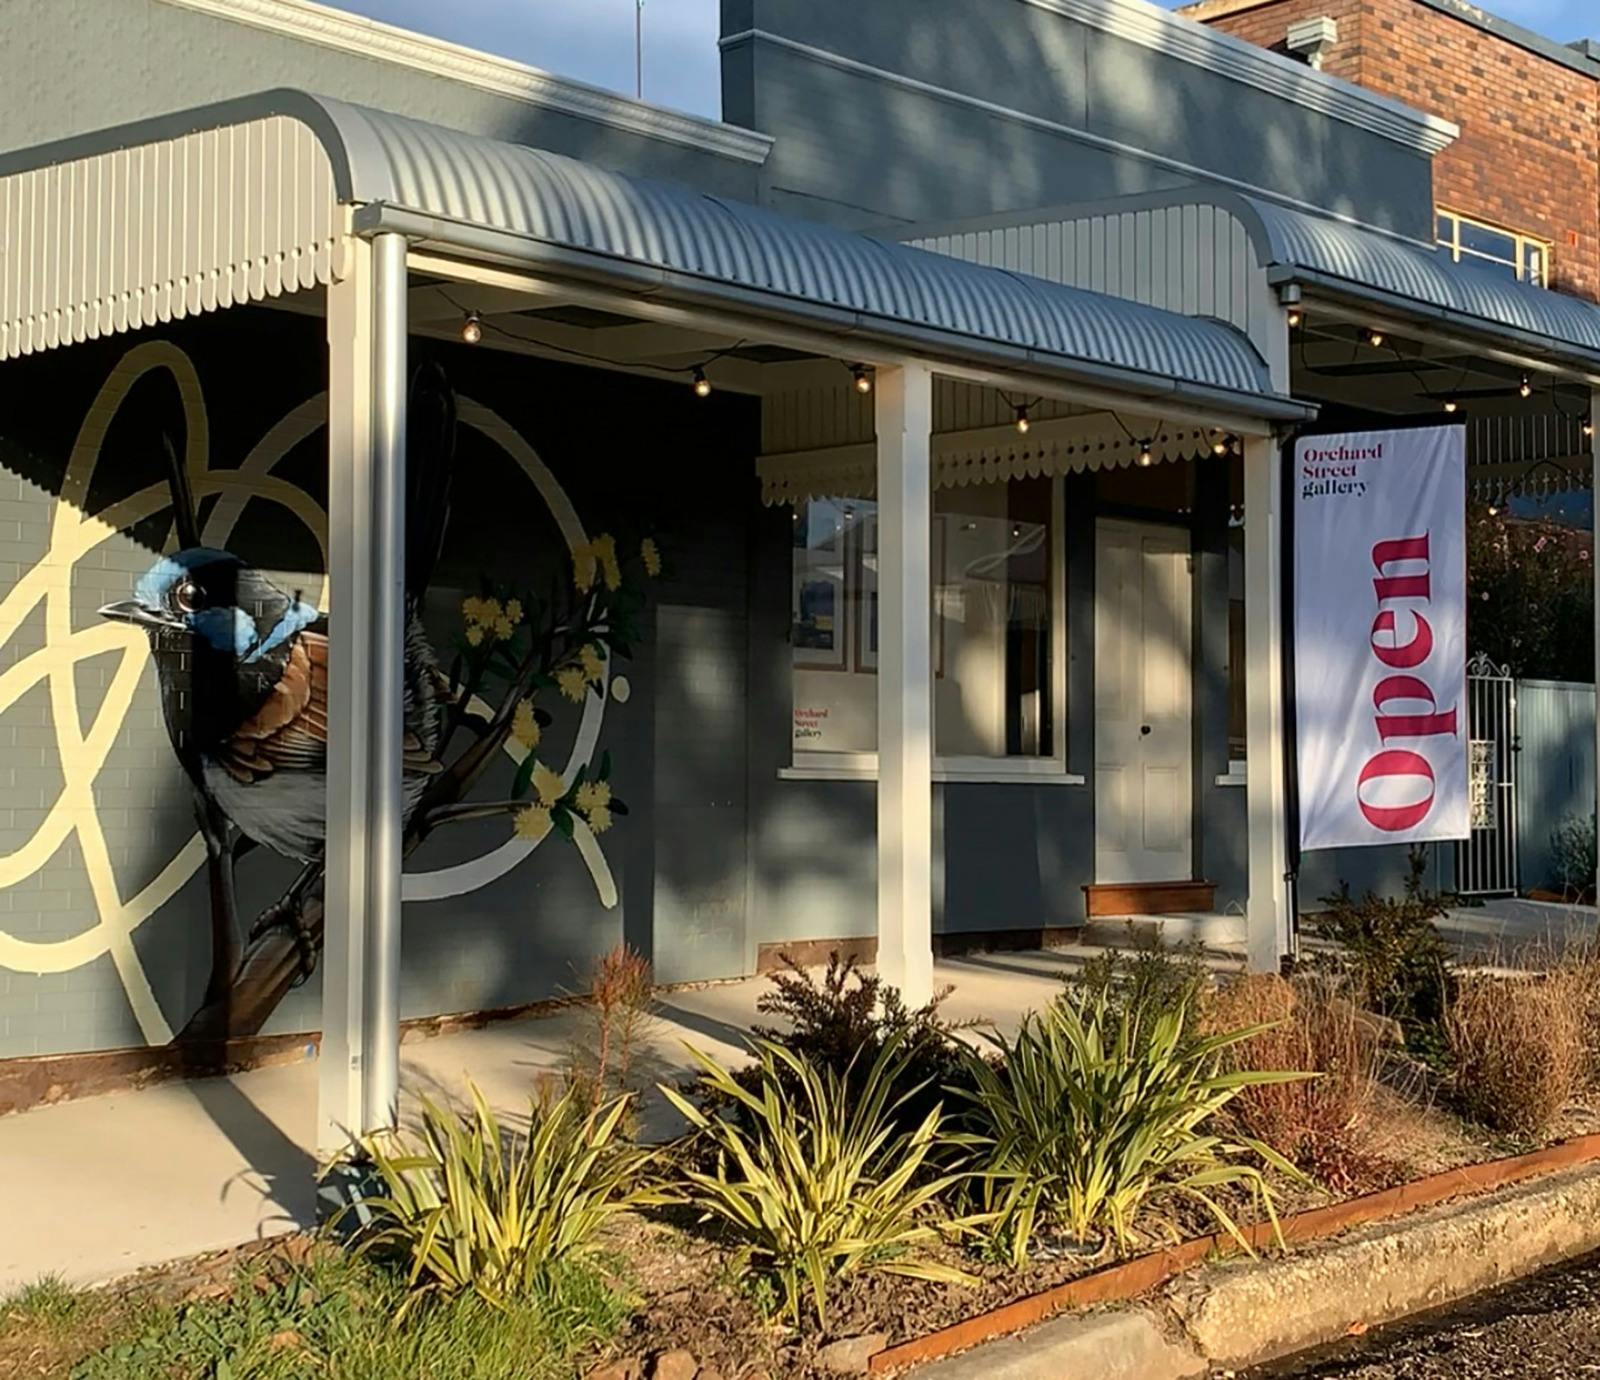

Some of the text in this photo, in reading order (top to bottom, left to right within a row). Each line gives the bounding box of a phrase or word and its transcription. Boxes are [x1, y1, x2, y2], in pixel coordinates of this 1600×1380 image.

[1303, 443, 1383, 462] Orchard
[1303, 464, 1356, 479] Street
[1302, 480, 1368, 500] gallery
[1357, 528, 1458, 832] open
